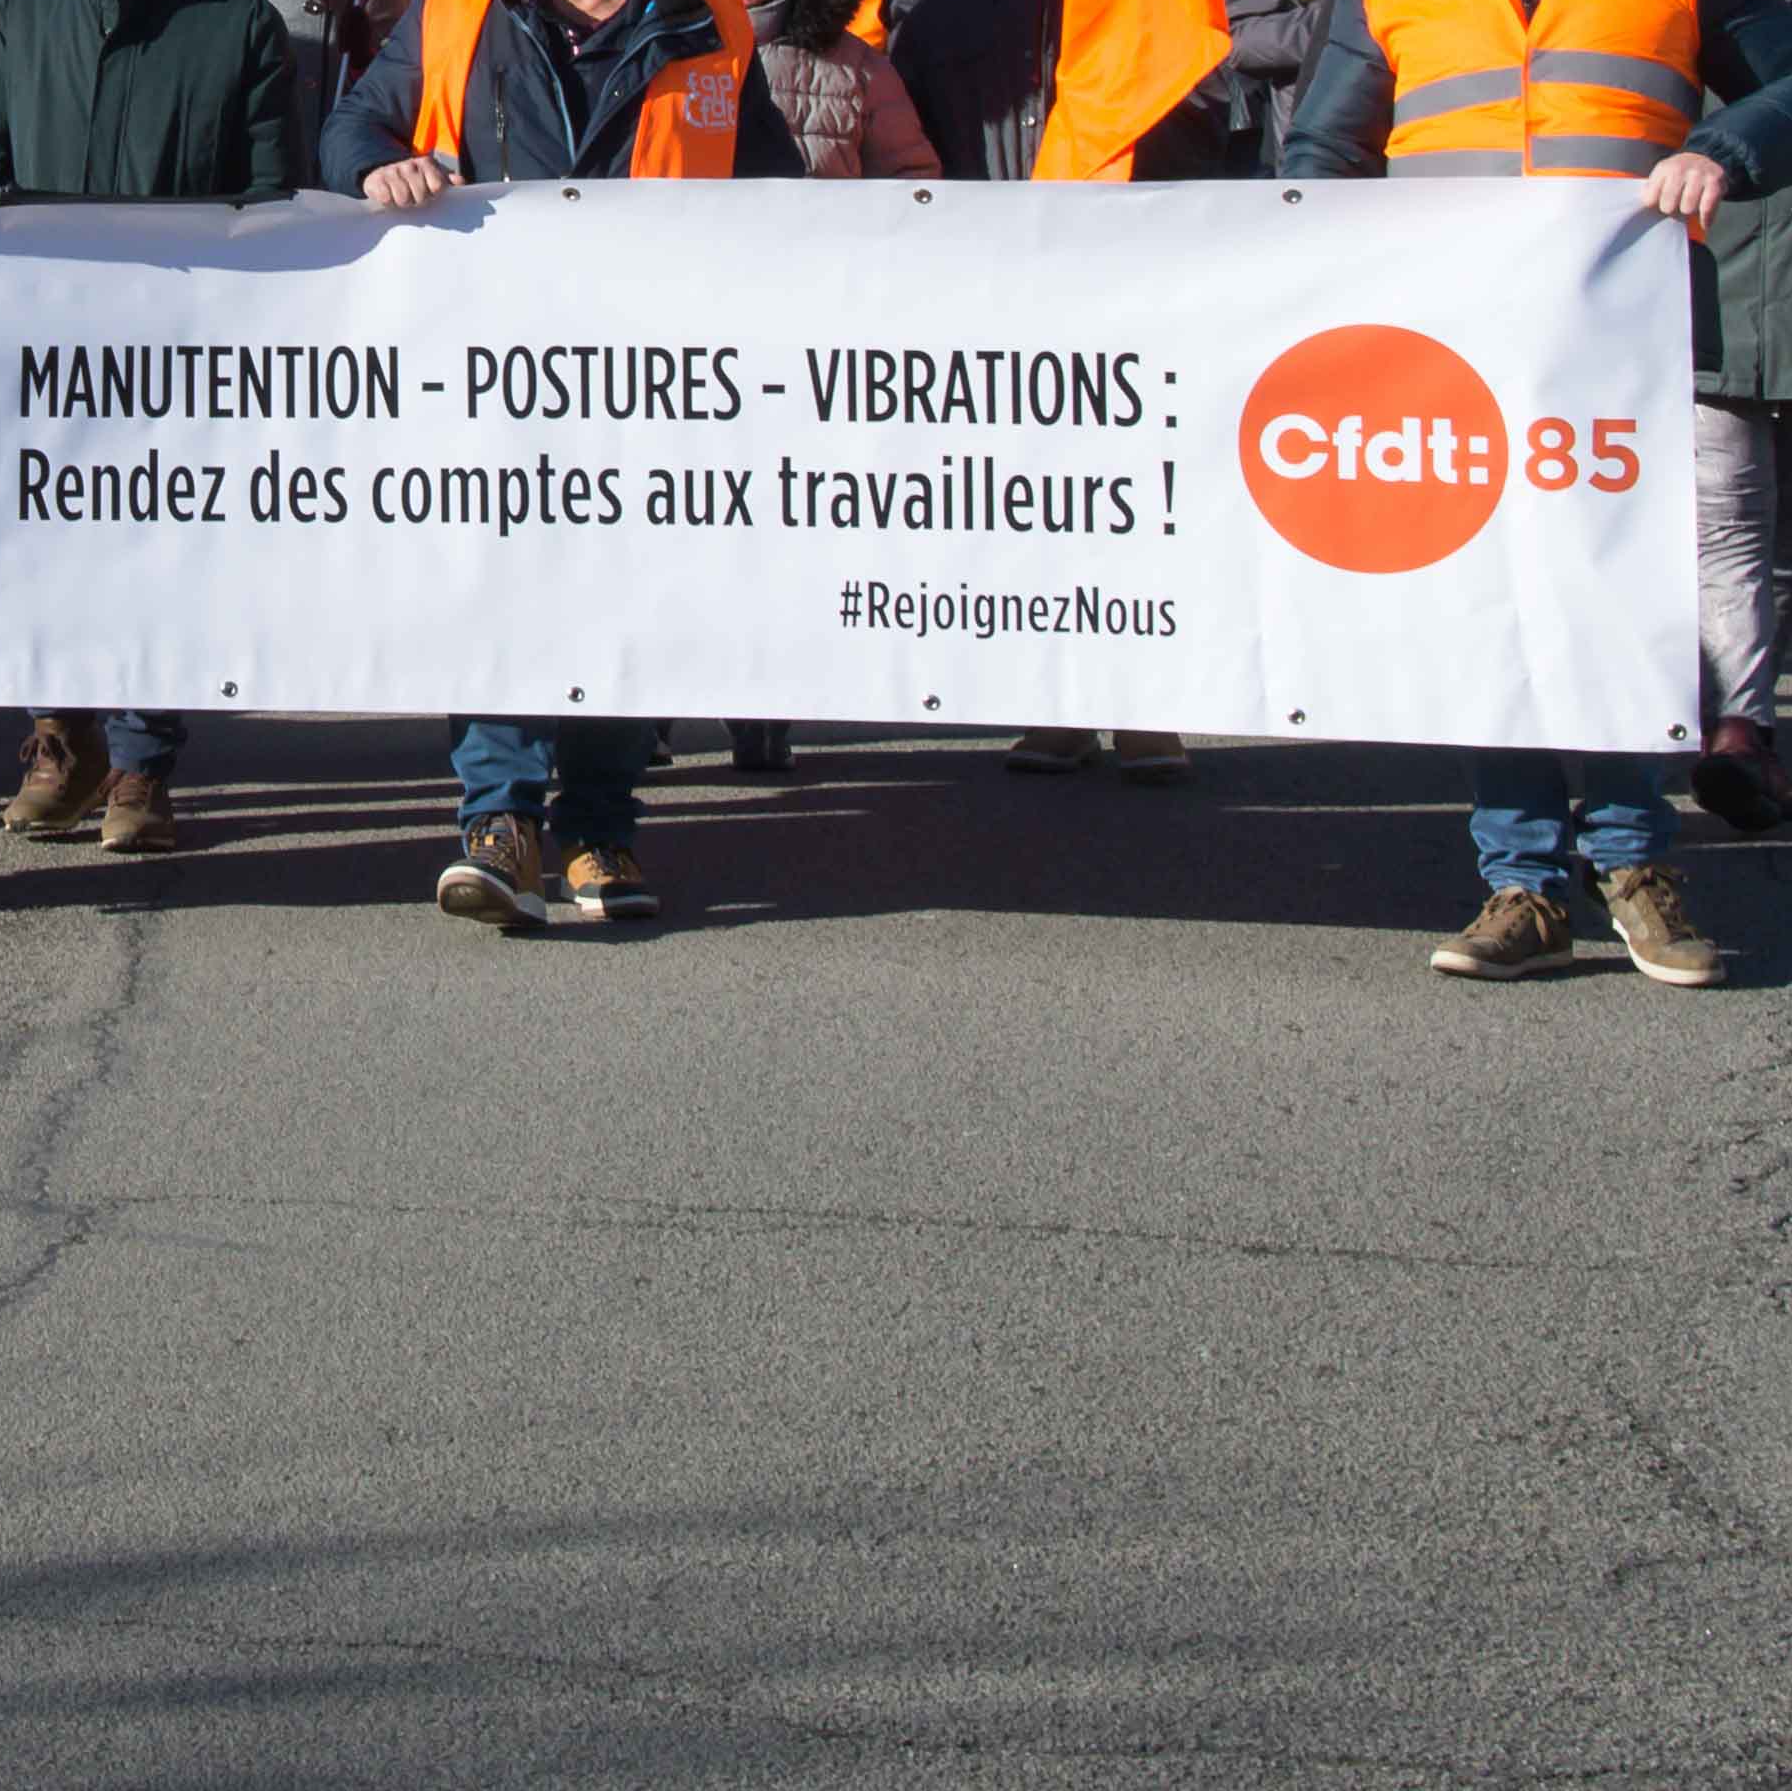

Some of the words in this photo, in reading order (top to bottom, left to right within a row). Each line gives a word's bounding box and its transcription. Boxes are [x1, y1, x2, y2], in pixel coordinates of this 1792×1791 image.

[20, 344, 401, 419] MANUTENTION
[466, 345, 742, 421] POSTURES
[807, 347, 1143, 428] VIBRATIONS
[19, 448, 227, 524] Rendez
[249, 449, 349, 525] des
[371, 453, 623, 538] comptes
[646, 467, 754, 527] aux
[778, 455, 1136, 535] travailleurs
[1259, 412, 1490, 486] Cfdt:
[1524, 416, 1641, 493] 85
[839, 580, 1177, 639] #RejoignezNous
